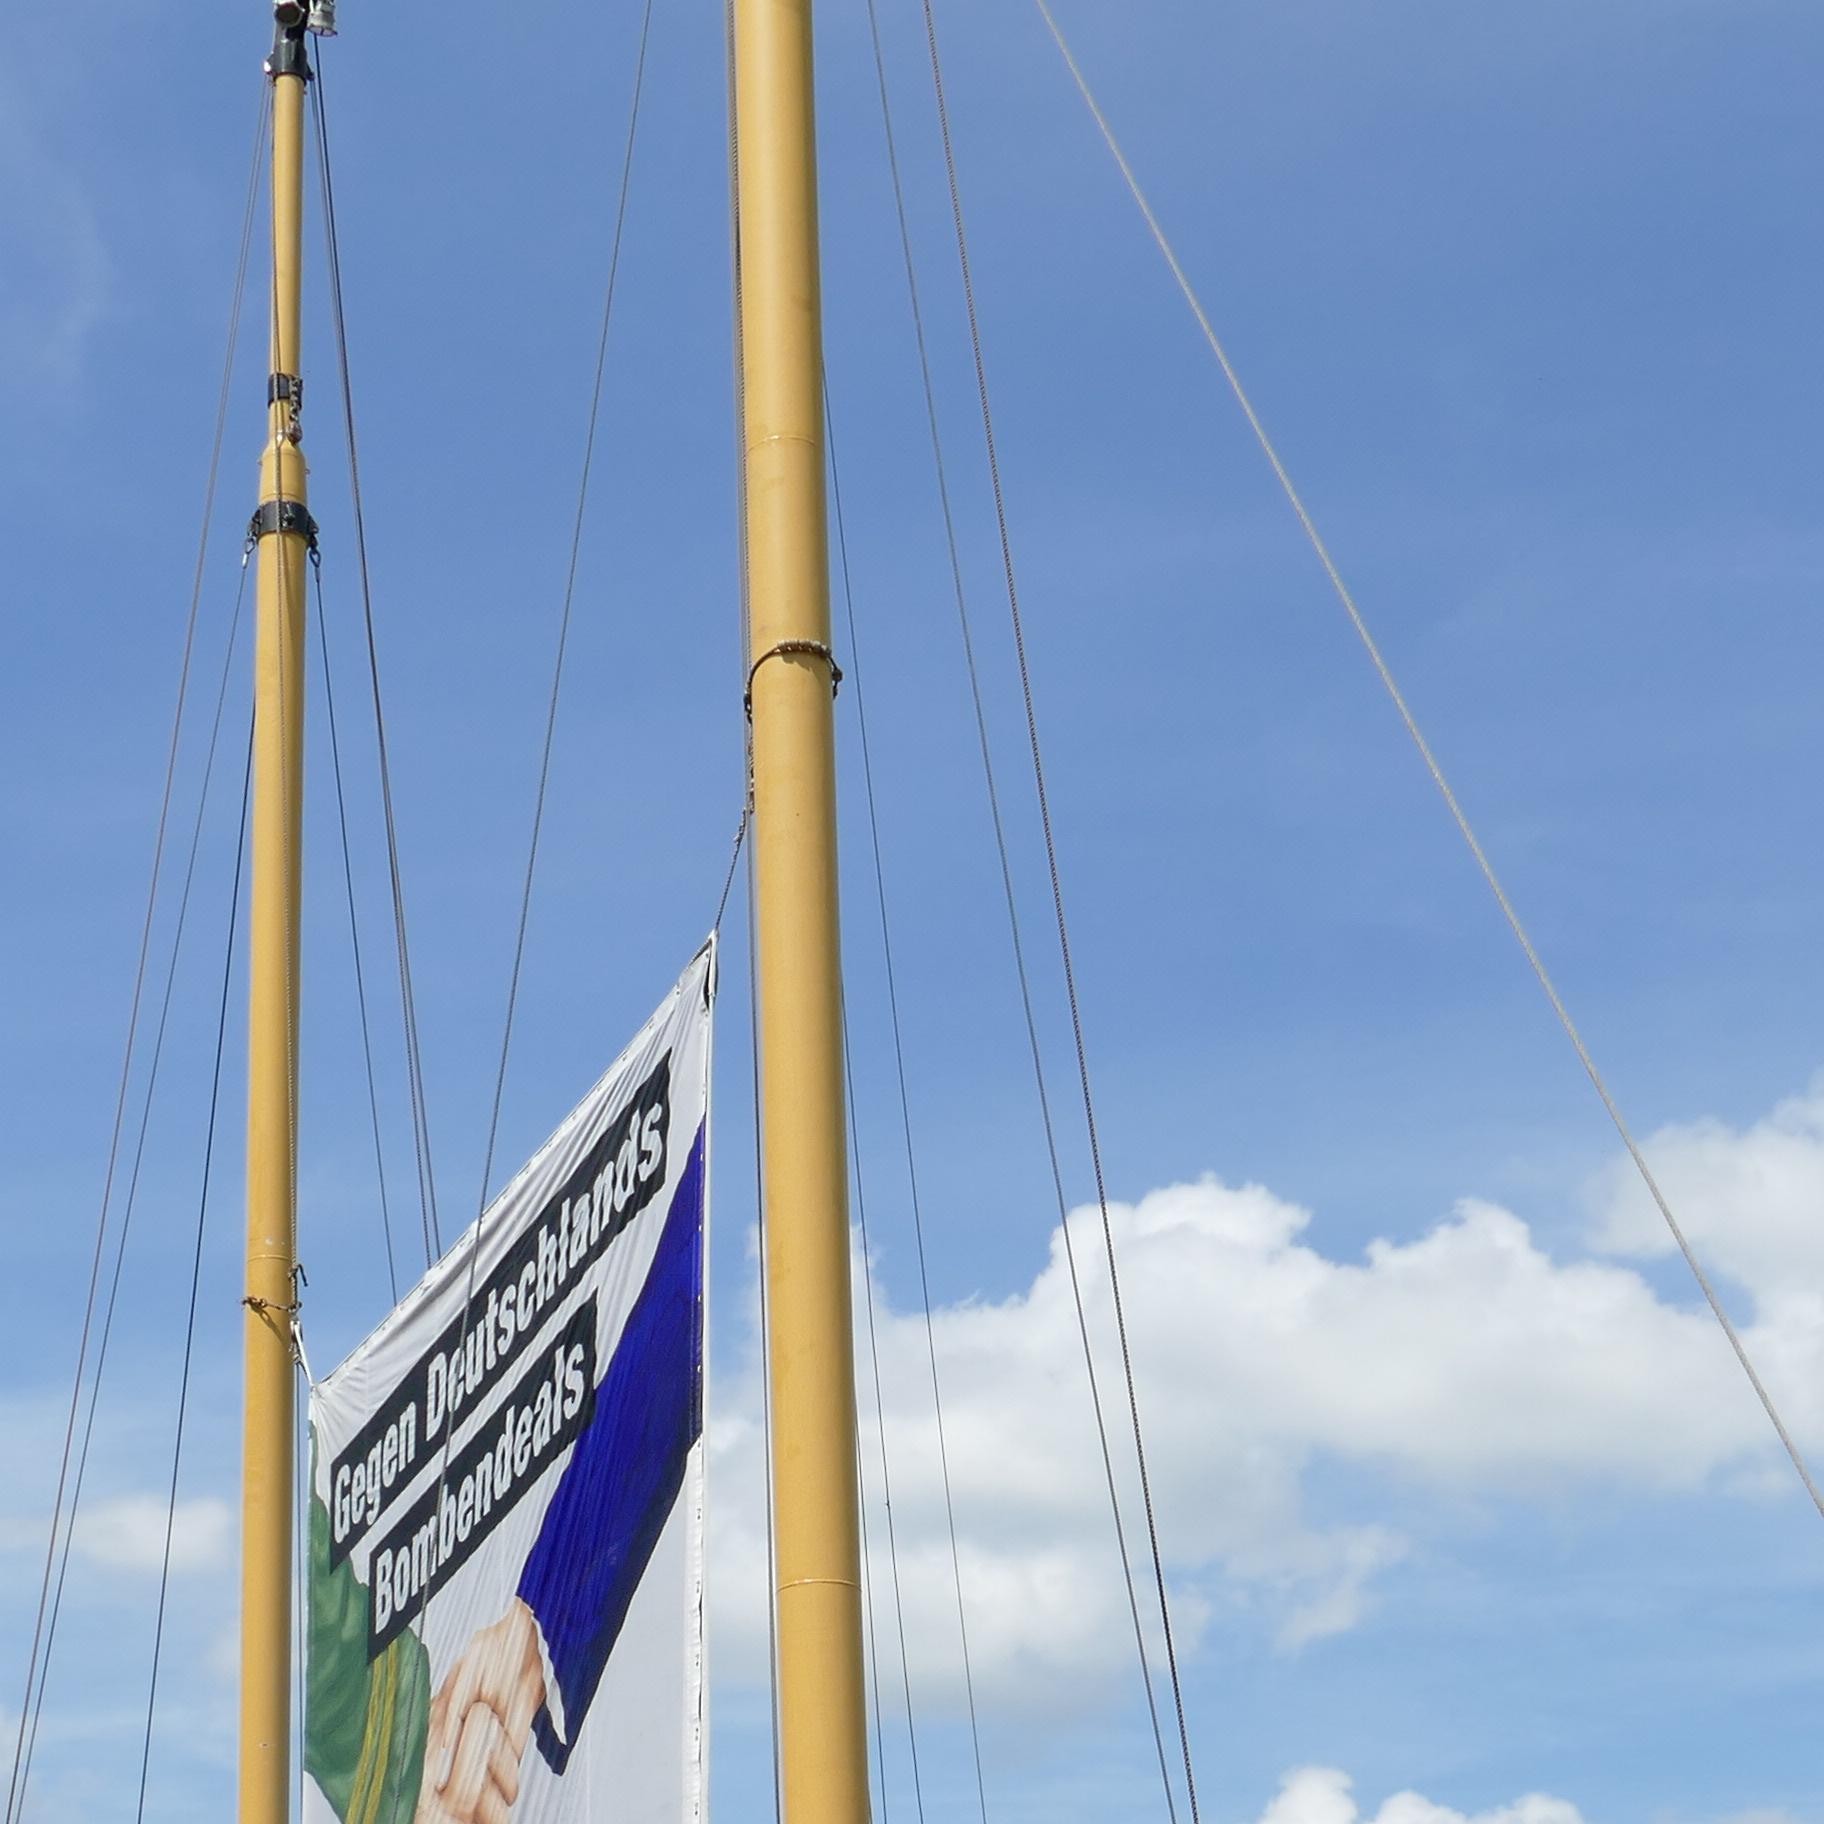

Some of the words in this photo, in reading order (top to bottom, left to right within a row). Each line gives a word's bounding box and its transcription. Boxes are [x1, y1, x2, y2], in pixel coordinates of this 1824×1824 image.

[332, 1397, 416, 1545] Gegen
[426, 1099, 663, 1443] Deutschlands
[375, 1338, 587, 1636] Bombendeals
